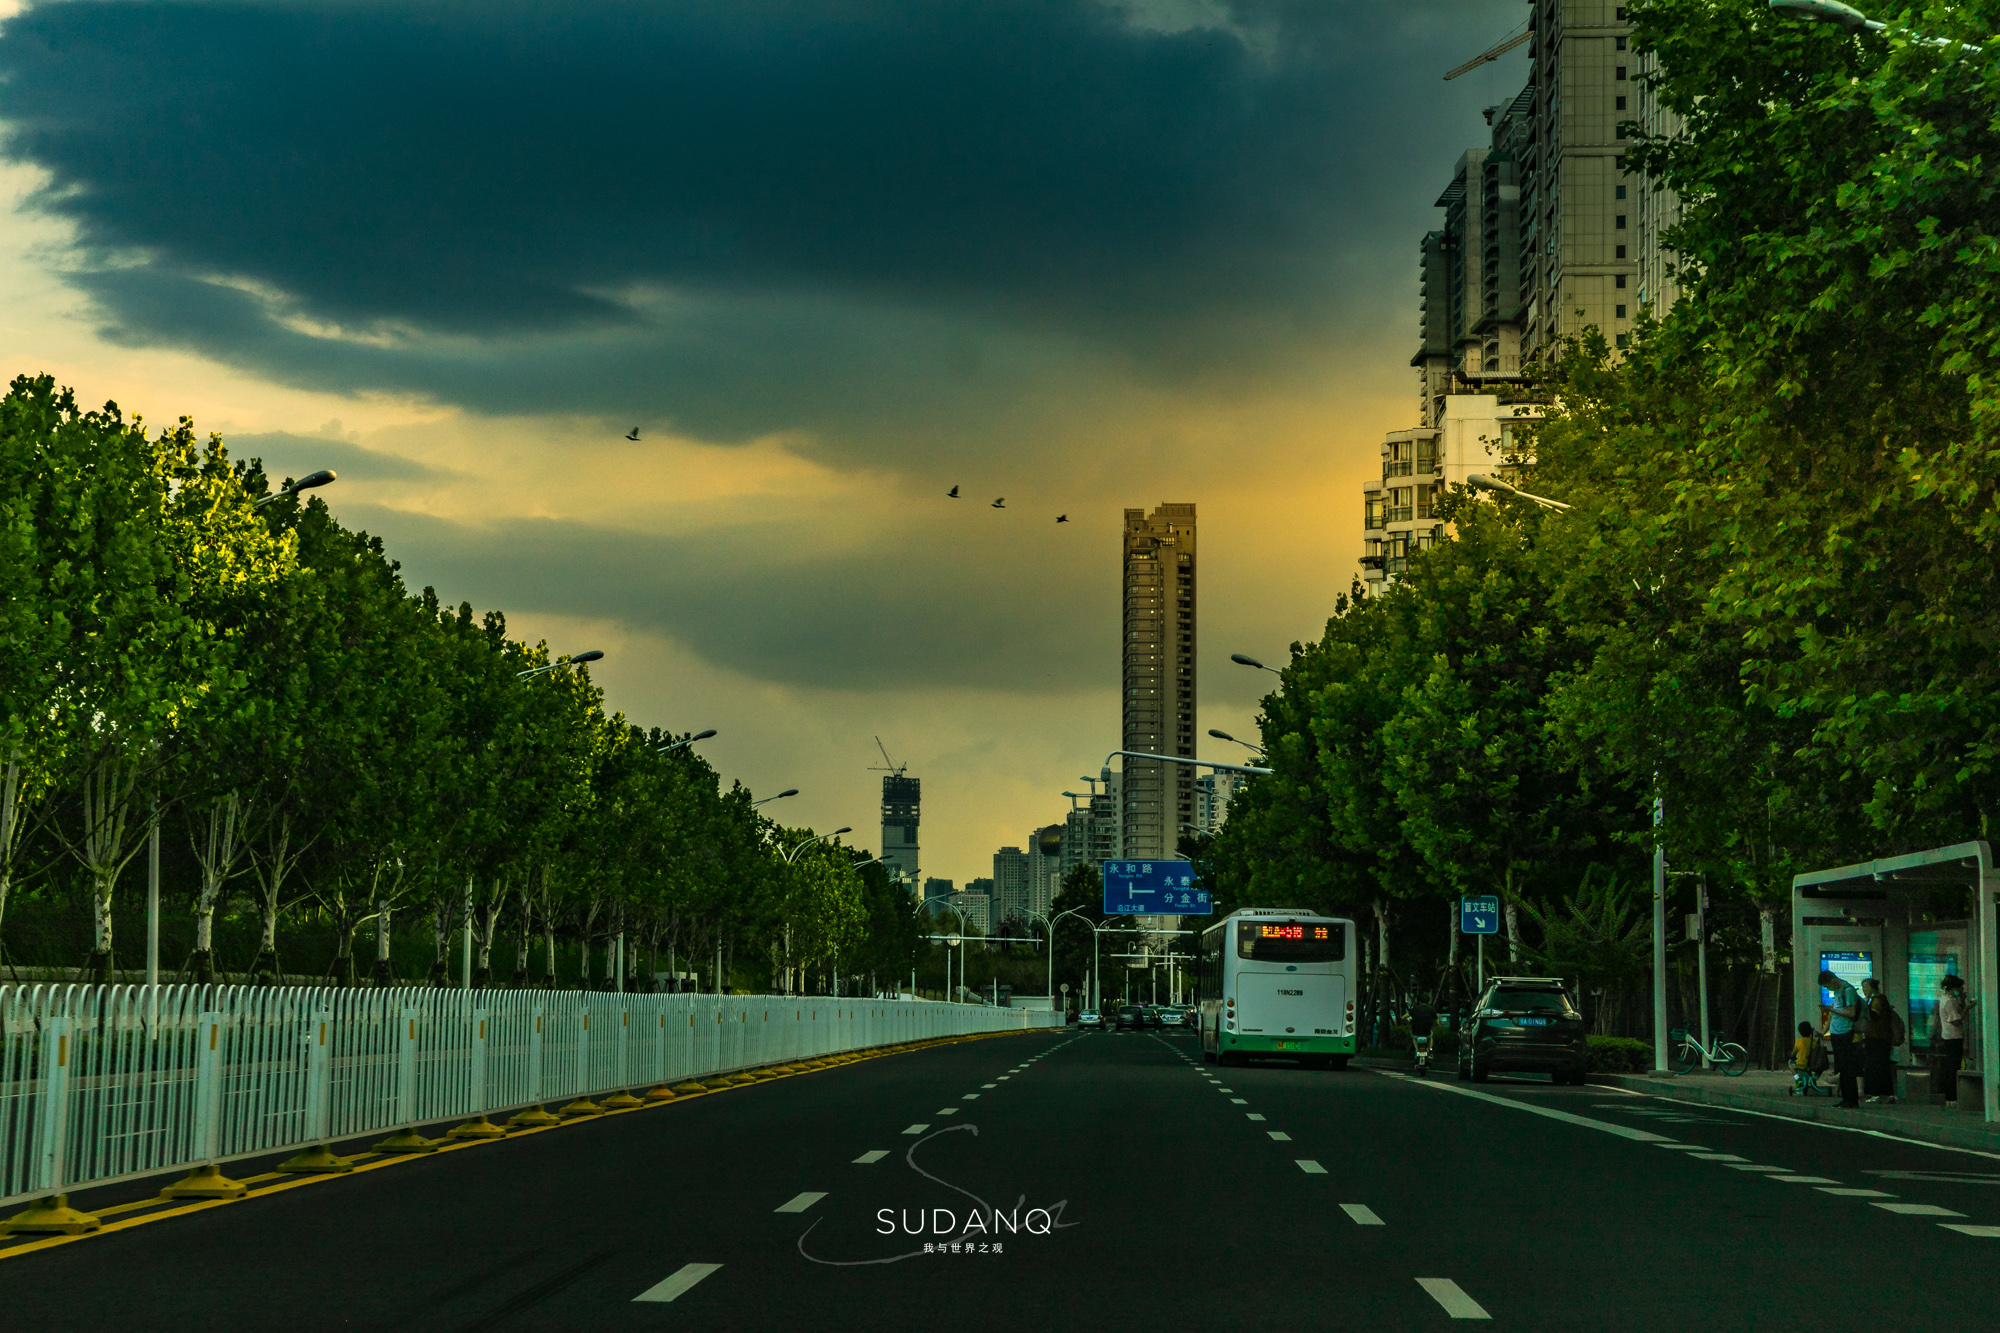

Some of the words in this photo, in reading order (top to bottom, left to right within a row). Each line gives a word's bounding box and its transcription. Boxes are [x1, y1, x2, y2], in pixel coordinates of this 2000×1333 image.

[1110, 864, 1152, 874] 永和路
[1164, 876, 1203, 886] 永泰
[1164, 893, 1207, 904] 分金街
[1464, 902, 1496, 913] 盲文车站
